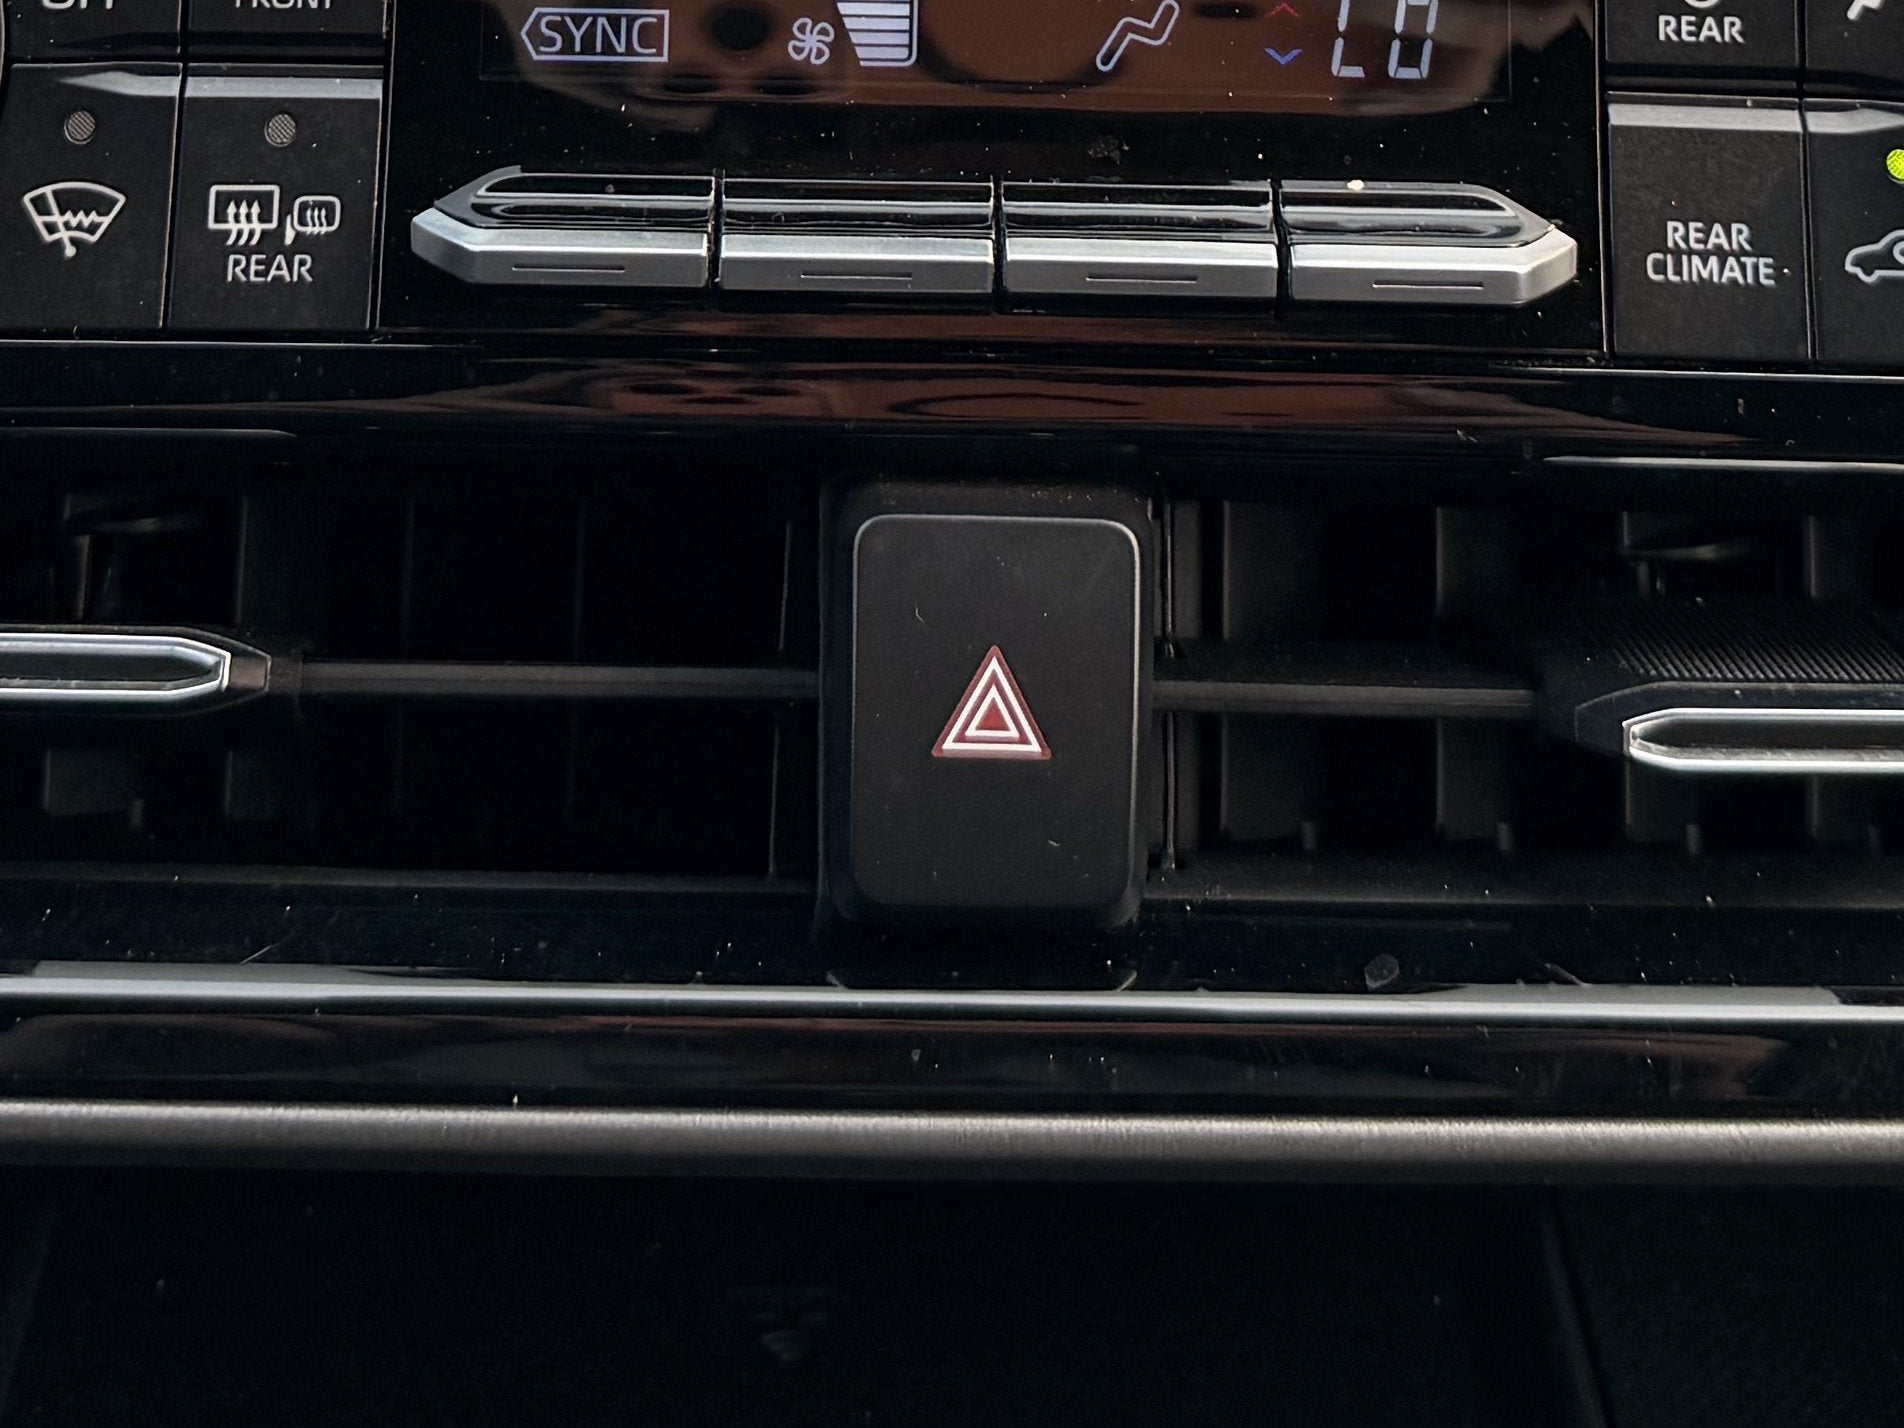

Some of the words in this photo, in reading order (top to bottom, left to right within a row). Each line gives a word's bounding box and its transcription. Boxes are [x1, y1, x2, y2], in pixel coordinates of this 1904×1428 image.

[538, 15, 658, 57] SYNC
[1657, 13, 1744, 46] REAR
[1666, 220, 1753, 252] REAR
[226, 252, 314, 284] REAR
[1646, 252, 1777, 287] CLIMATE
